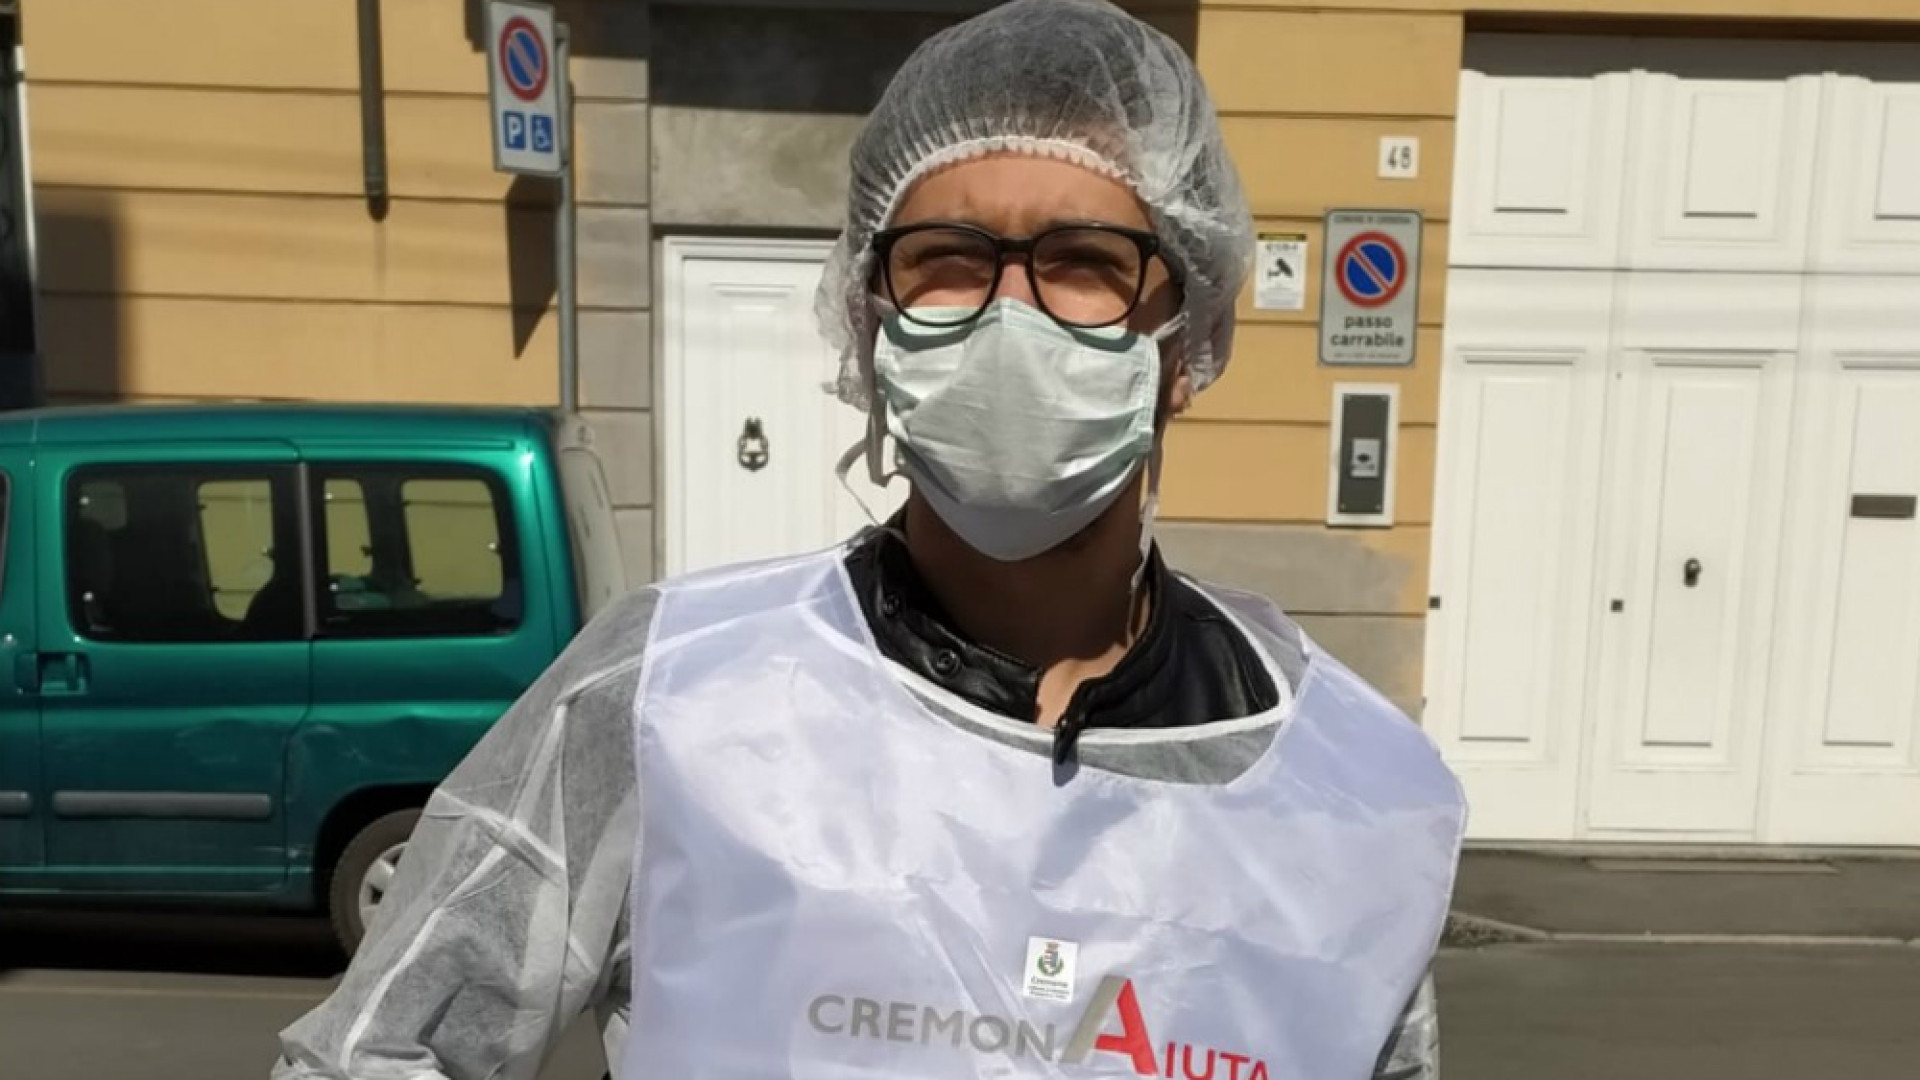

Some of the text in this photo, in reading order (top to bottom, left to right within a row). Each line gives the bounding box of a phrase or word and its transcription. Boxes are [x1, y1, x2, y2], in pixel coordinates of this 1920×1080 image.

[508, 115, 522, 146] P
[1387, 145, 1411, 170] 48
[1343, 316, 1393, 330] passo
[1330, 331, 1404, 347] carrabile
